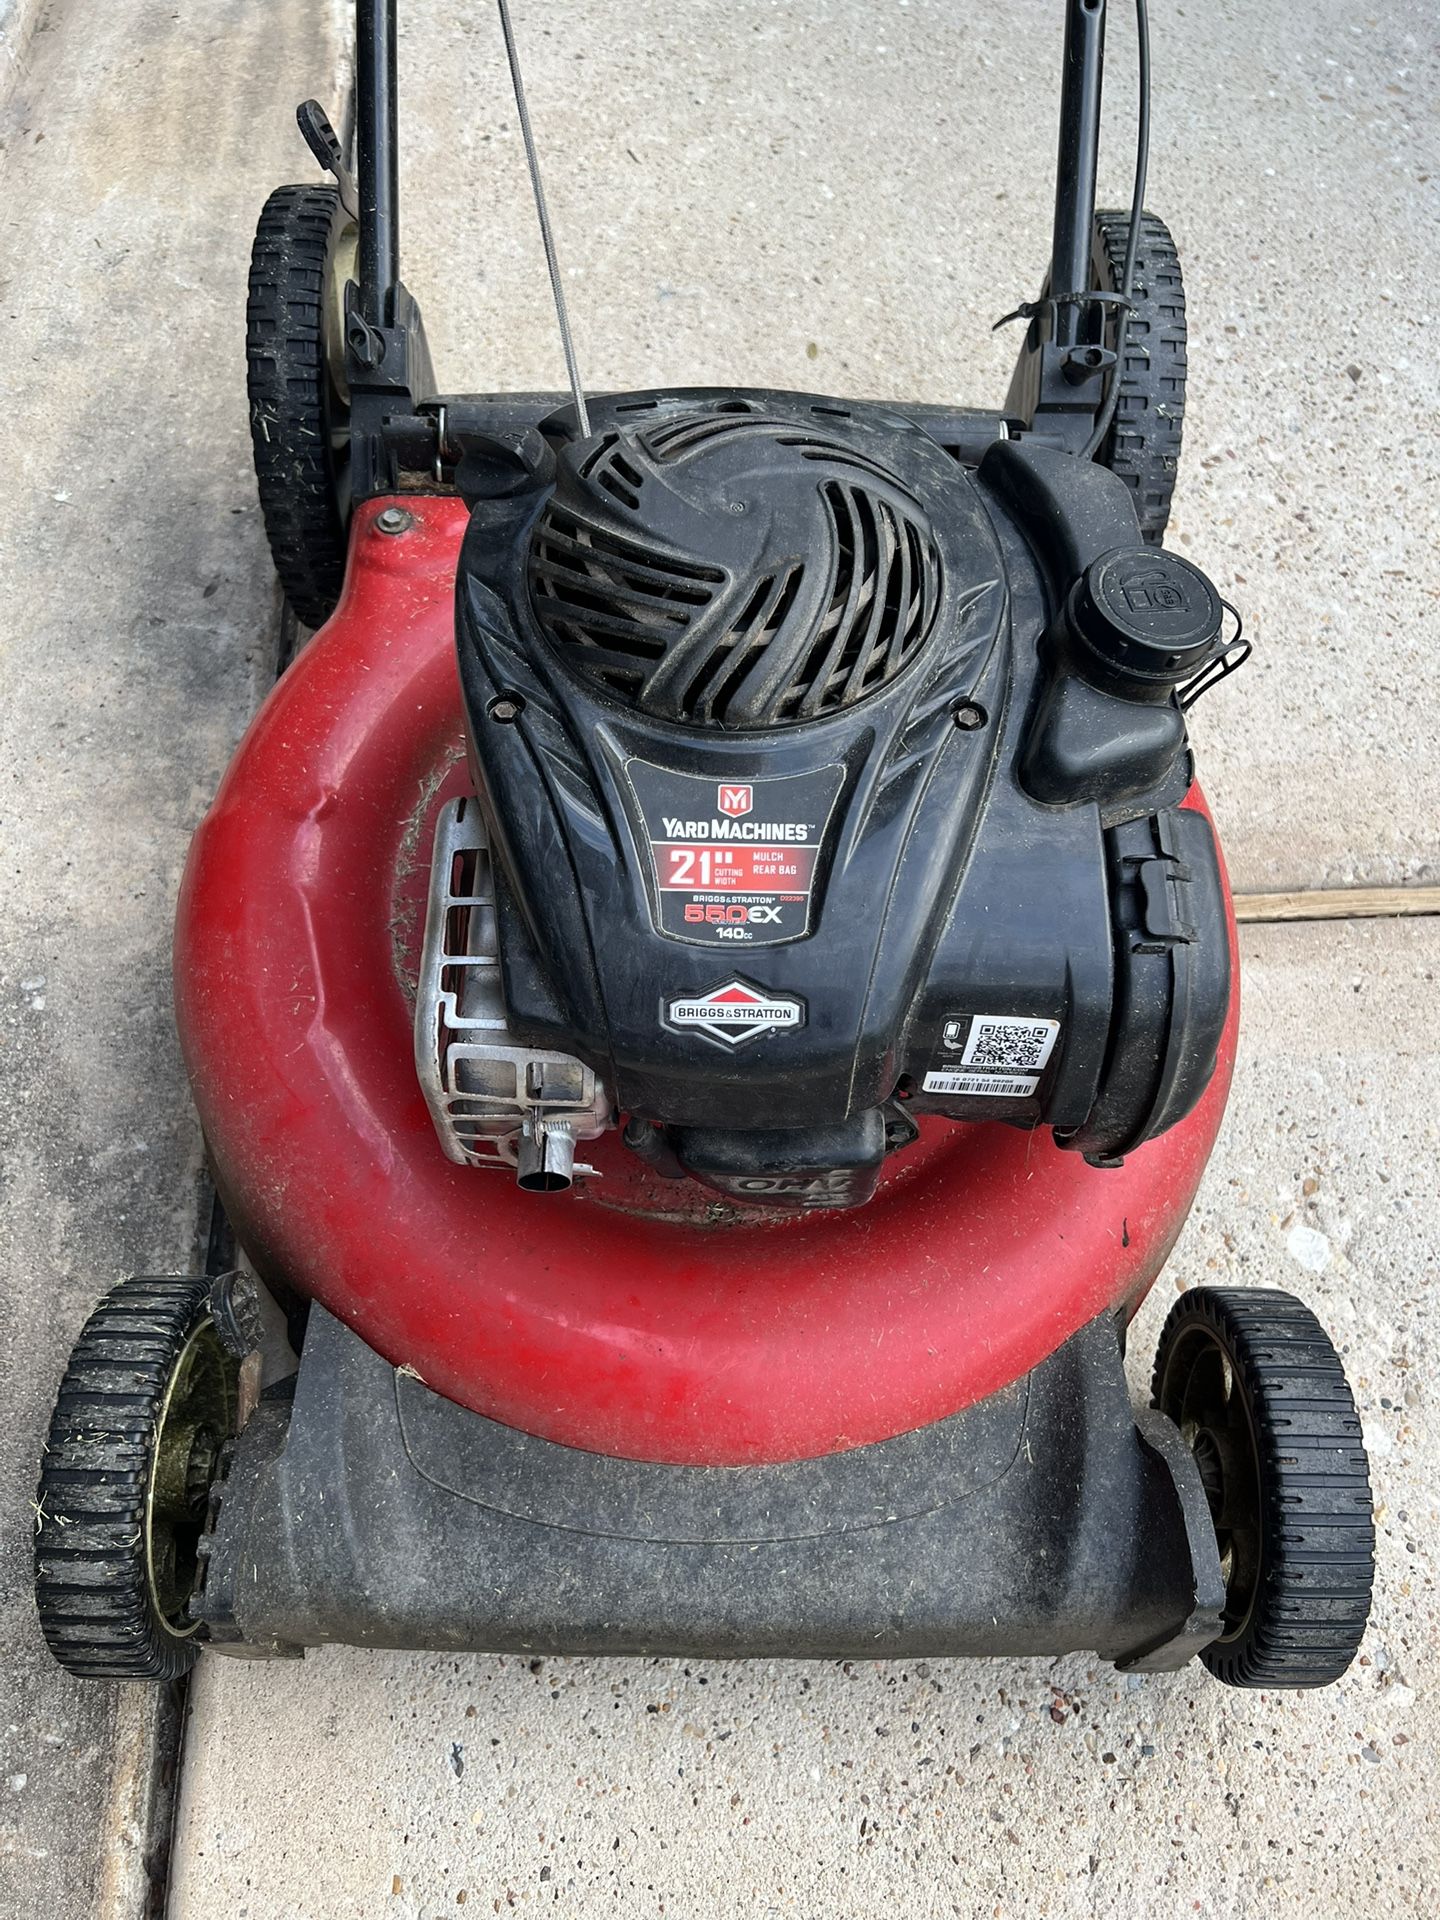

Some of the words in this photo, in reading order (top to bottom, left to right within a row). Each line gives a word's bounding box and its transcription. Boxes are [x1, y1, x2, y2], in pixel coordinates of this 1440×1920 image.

[662, 817, 709, 838] YARD
[752, 852, 784, 862] MULCH
[714, 868, 743, 878] CUTTING
[752, 864, 776, 875] REAR
[778, 865, 797, 875] BAG
[714, 877, 736, 885] WIDTH
[678, 1007, 792, 1020] BRIGGS&STRATTON
